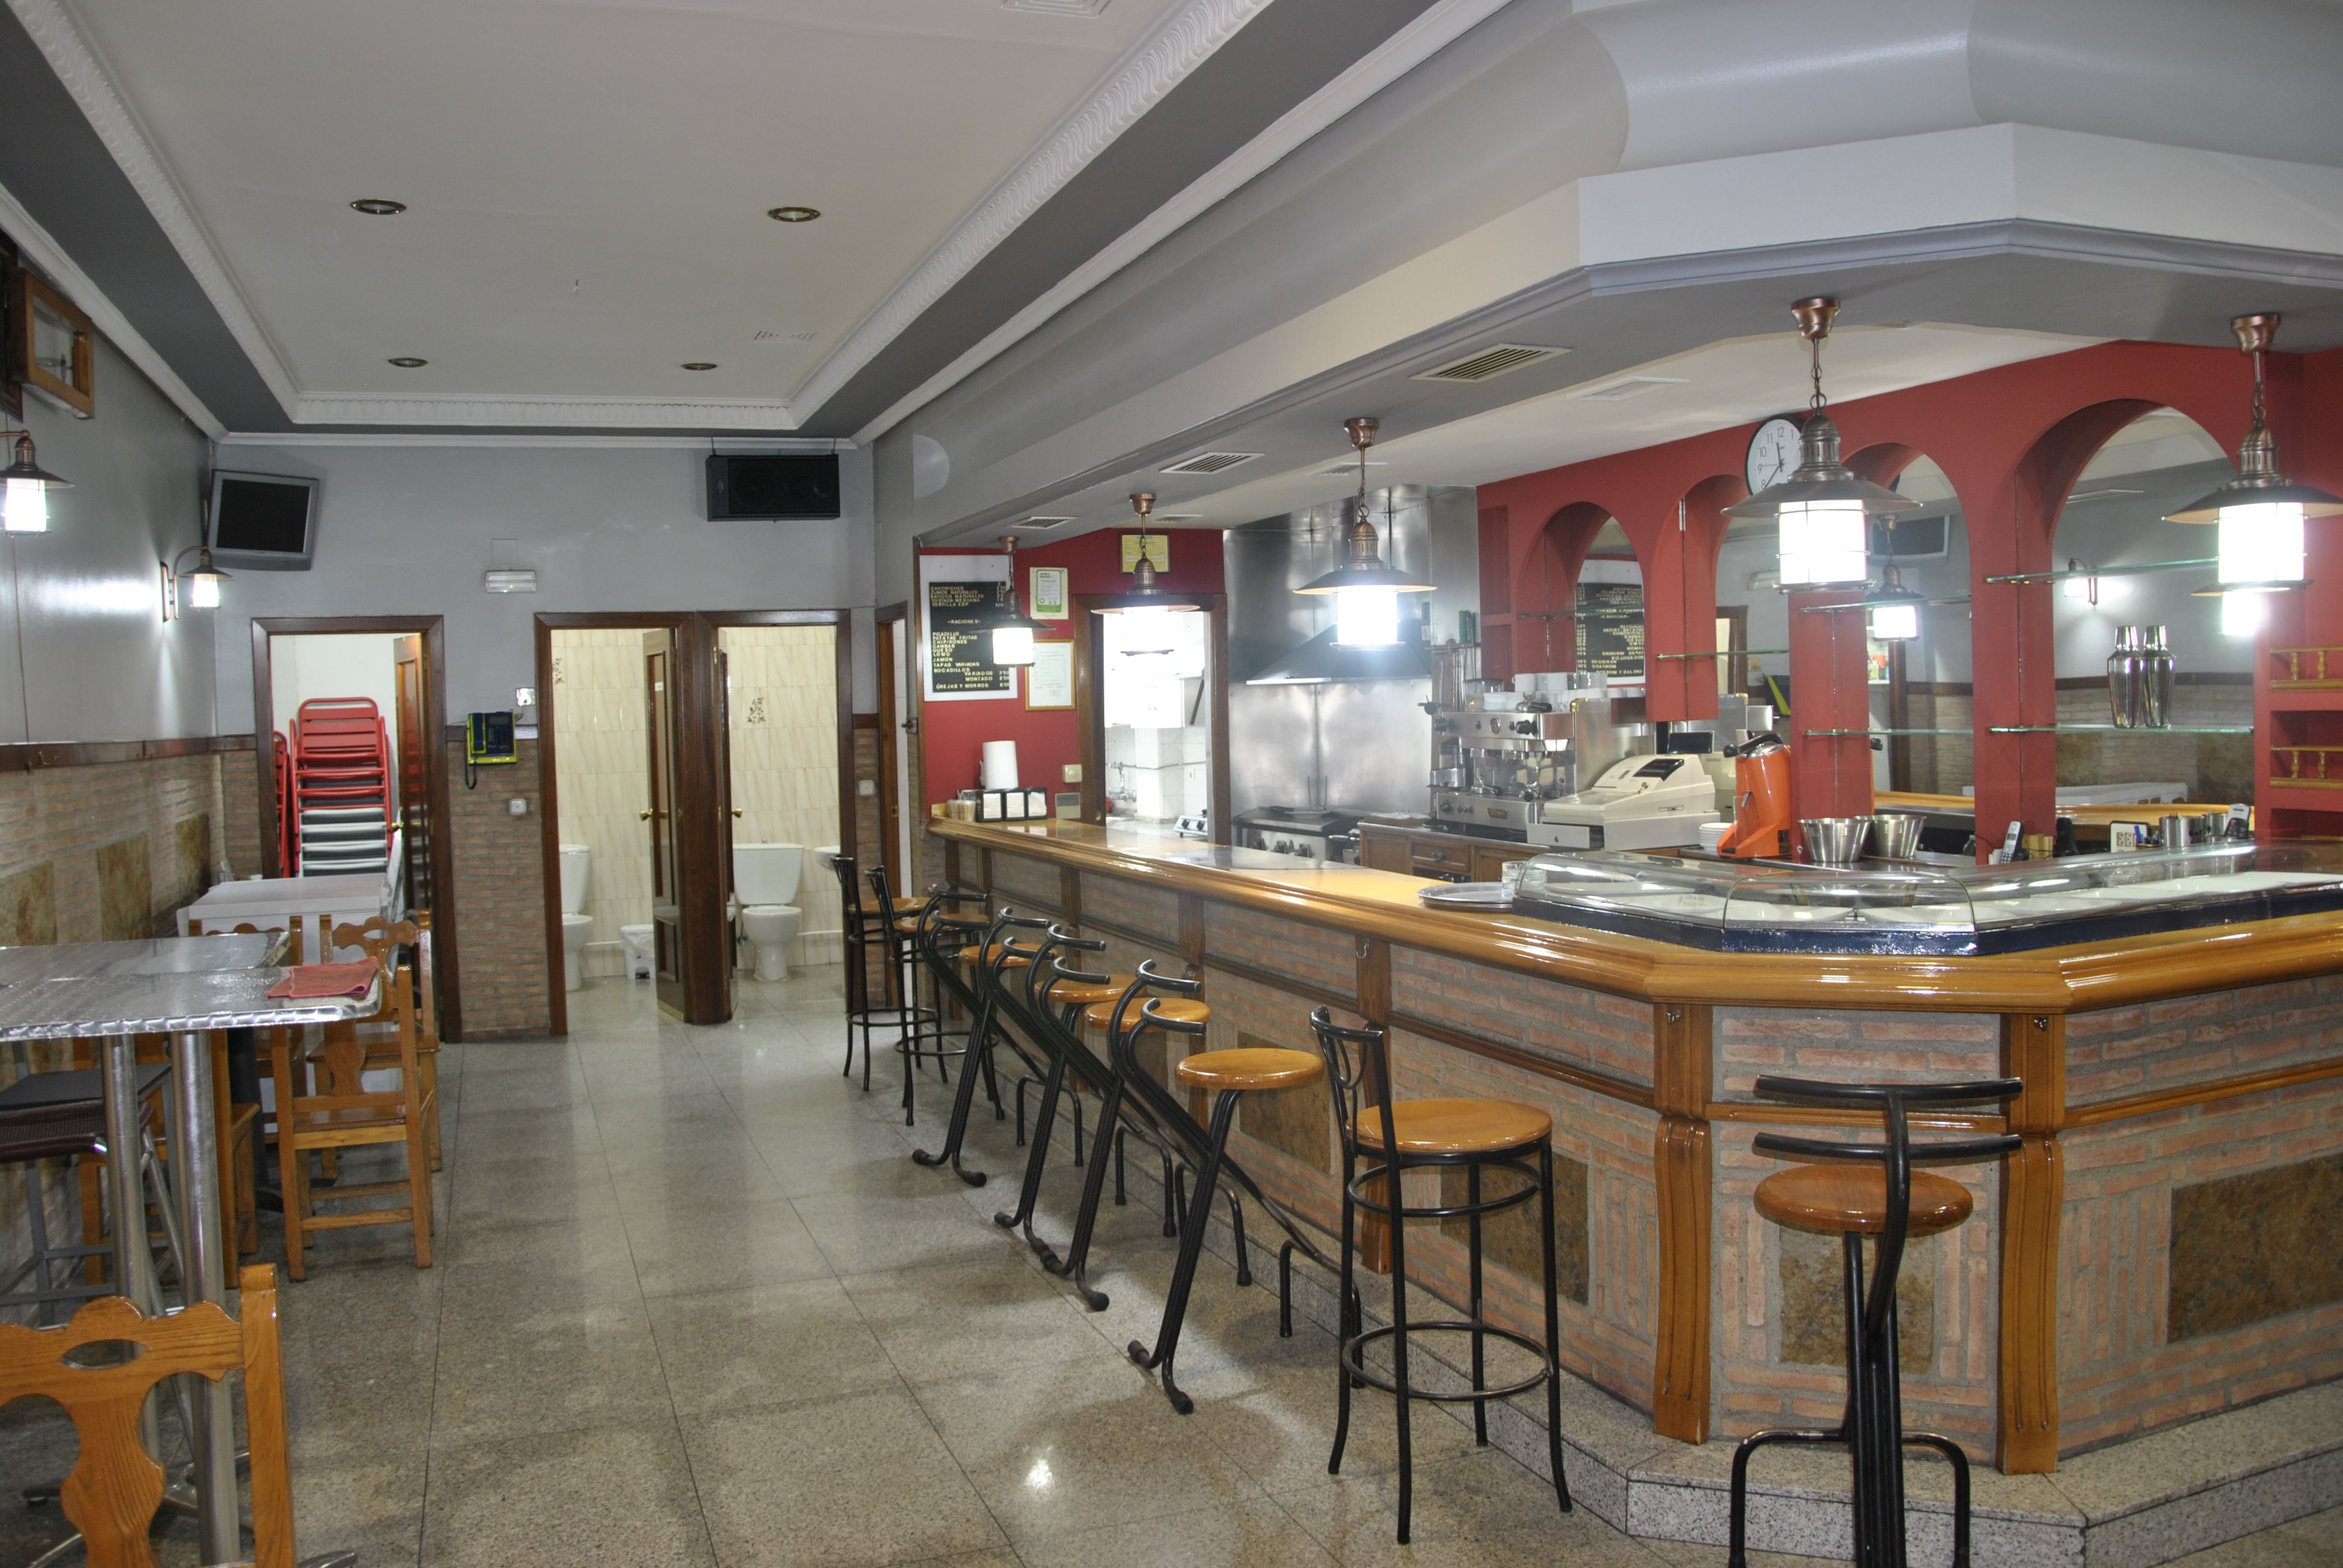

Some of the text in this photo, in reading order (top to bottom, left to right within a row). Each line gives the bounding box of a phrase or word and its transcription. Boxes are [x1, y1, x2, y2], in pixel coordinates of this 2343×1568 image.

[1777, 426, 1784, 437] 12
[1767, 433, 1773, 443] 11
[1758, 446, 1766, 457] 10
[1757, 463, 1762, 474] 9
[1761, 479, 1766, 489] 8
